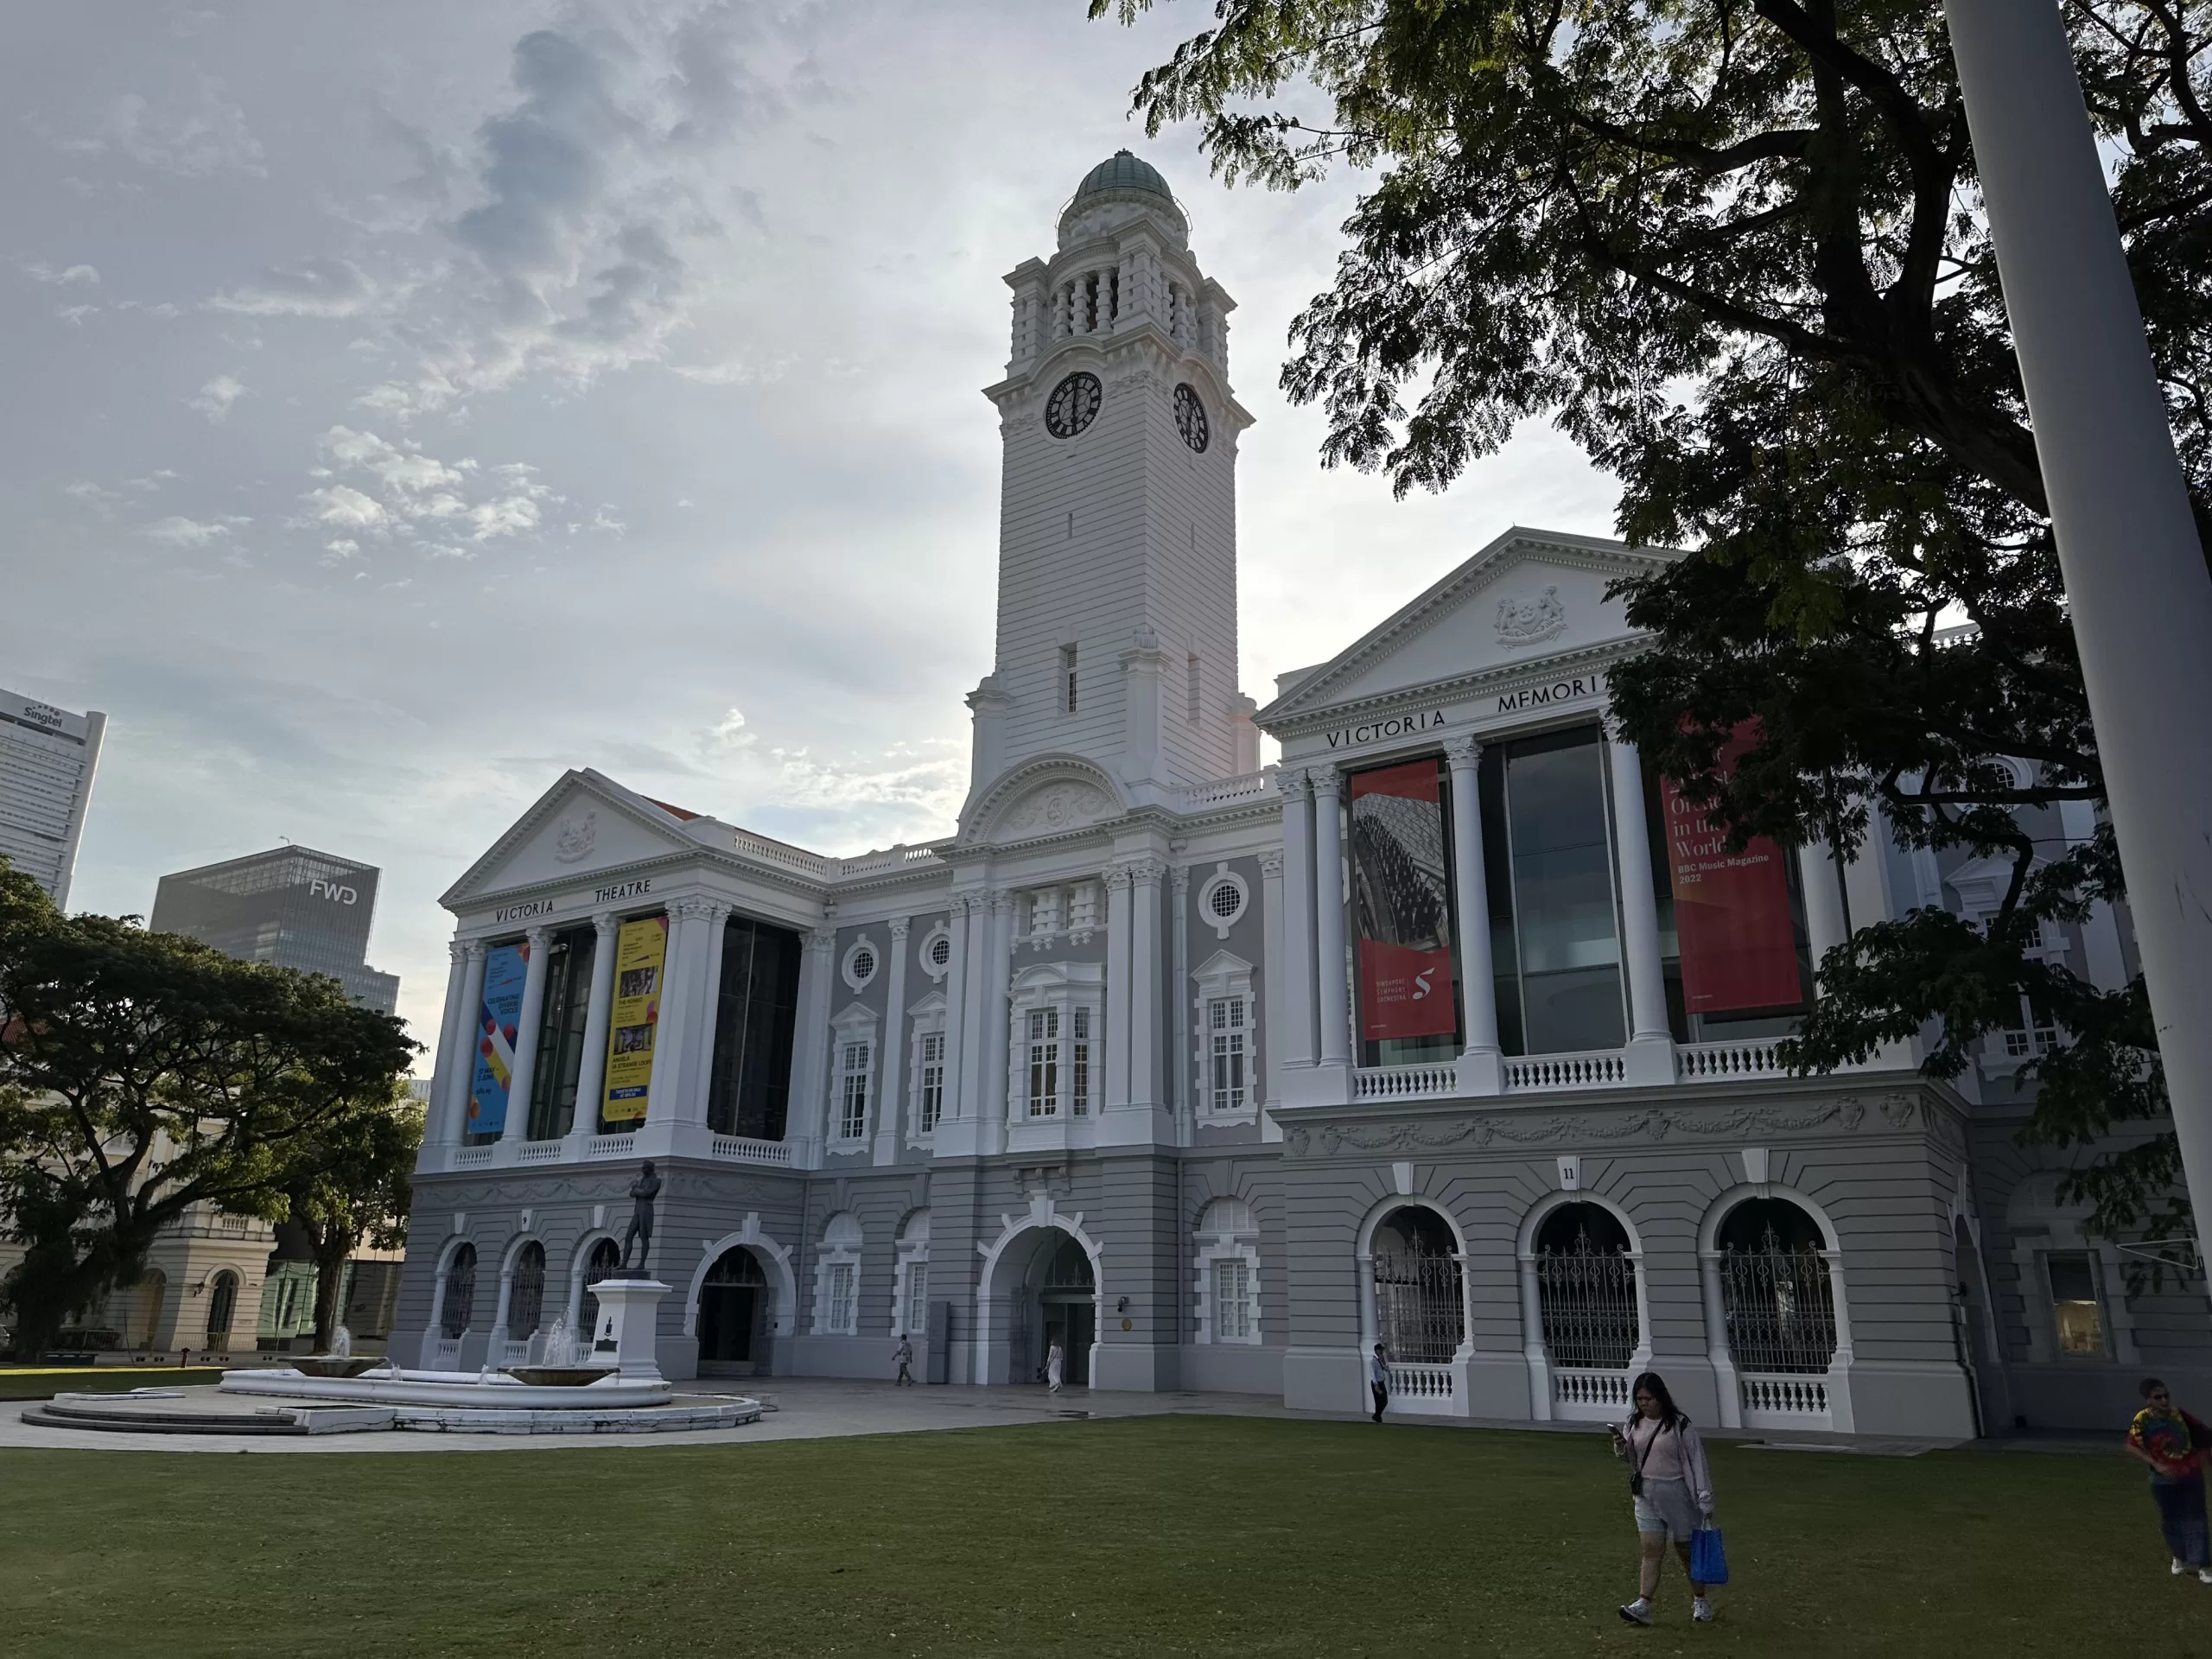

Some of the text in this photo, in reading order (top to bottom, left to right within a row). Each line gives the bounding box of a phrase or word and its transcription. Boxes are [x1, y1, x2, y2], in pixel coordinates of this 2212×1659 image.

[24, 705, 62, 728] Singtel
[1326, 710, 1446, 747] VICTORIA
[1674, 820, 1691, 836] in
[1675, 835, 1726, 858] World
[1678, 855, 1770, 874] BBC Music Magazine
[1679, 874, 1703, 884] 2022
[309, 878, 358, 906] FWD
[496, 880, 652, 923] VICTORIA THEATRE
[1376, 994, 1407, 1003] ORCHESTRA
[1563, 1167, 1574, 1179] 11
